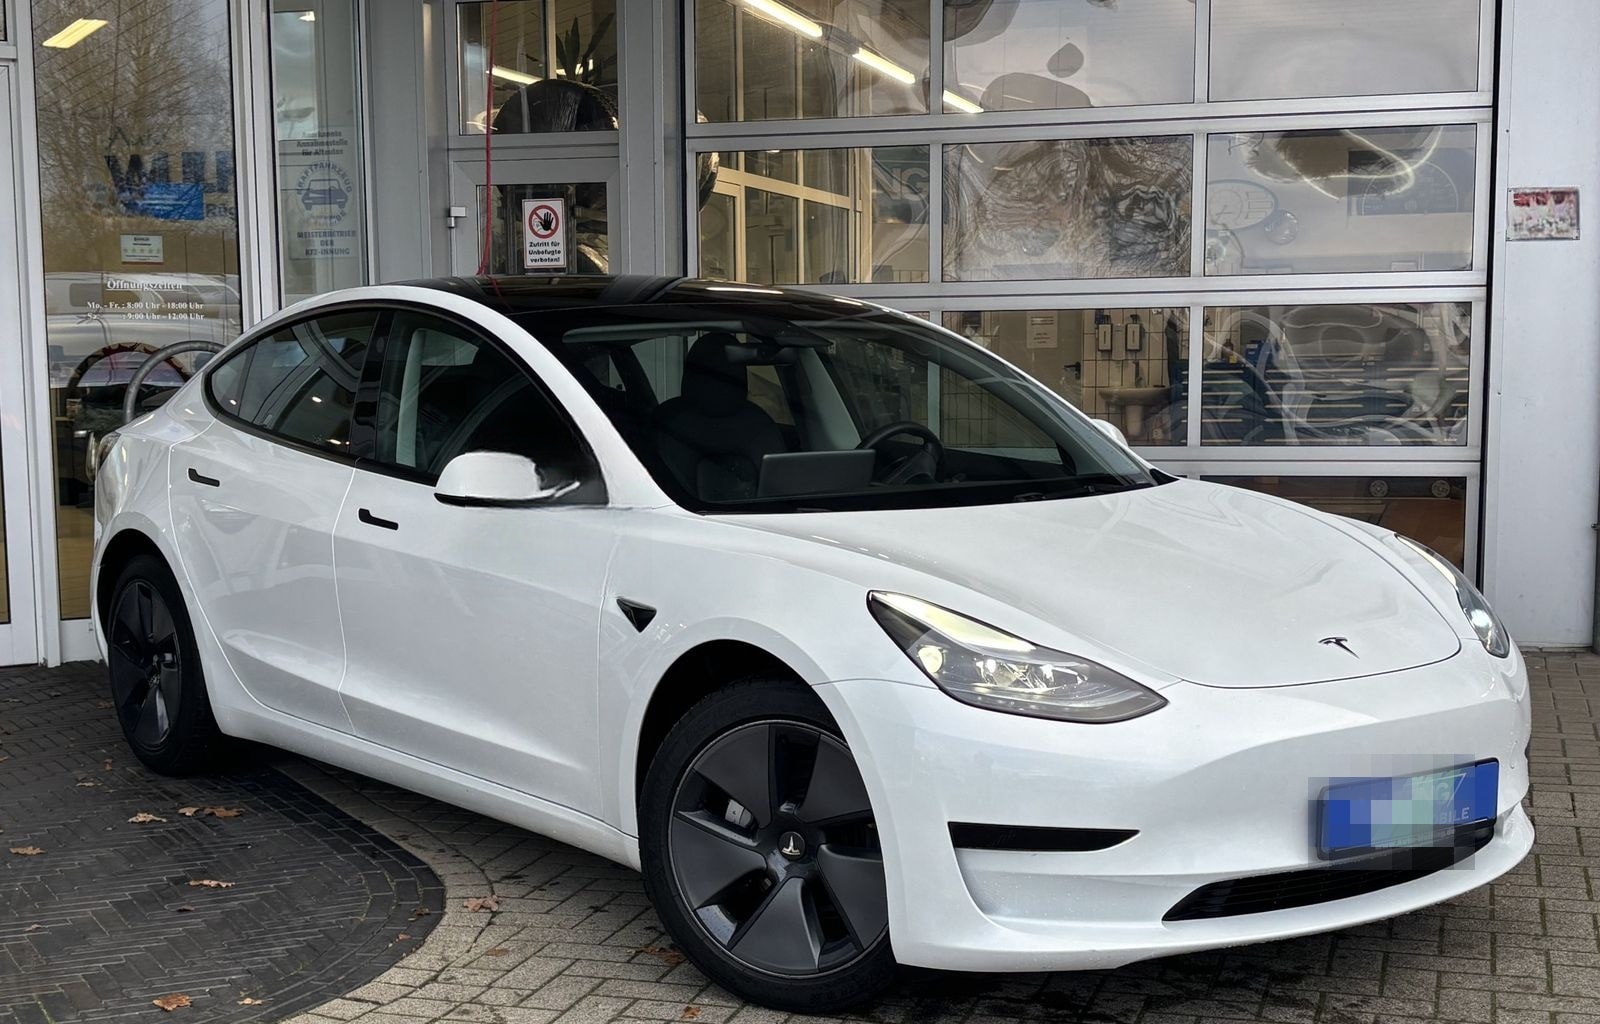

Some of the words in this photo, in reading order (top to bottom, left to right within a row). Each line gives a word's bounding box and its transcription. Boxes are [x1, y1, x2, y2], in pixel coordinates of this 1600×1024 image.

[126, 301, 144, 309] 8:00
[145, 301, 160, 309] Uhr
[167, 301, 188, 309] 18:00
[189, 301, 204, 309] Uhr
[145, 312, 161, 320] Uhr
[189, 312, 205, 320] Uhr
